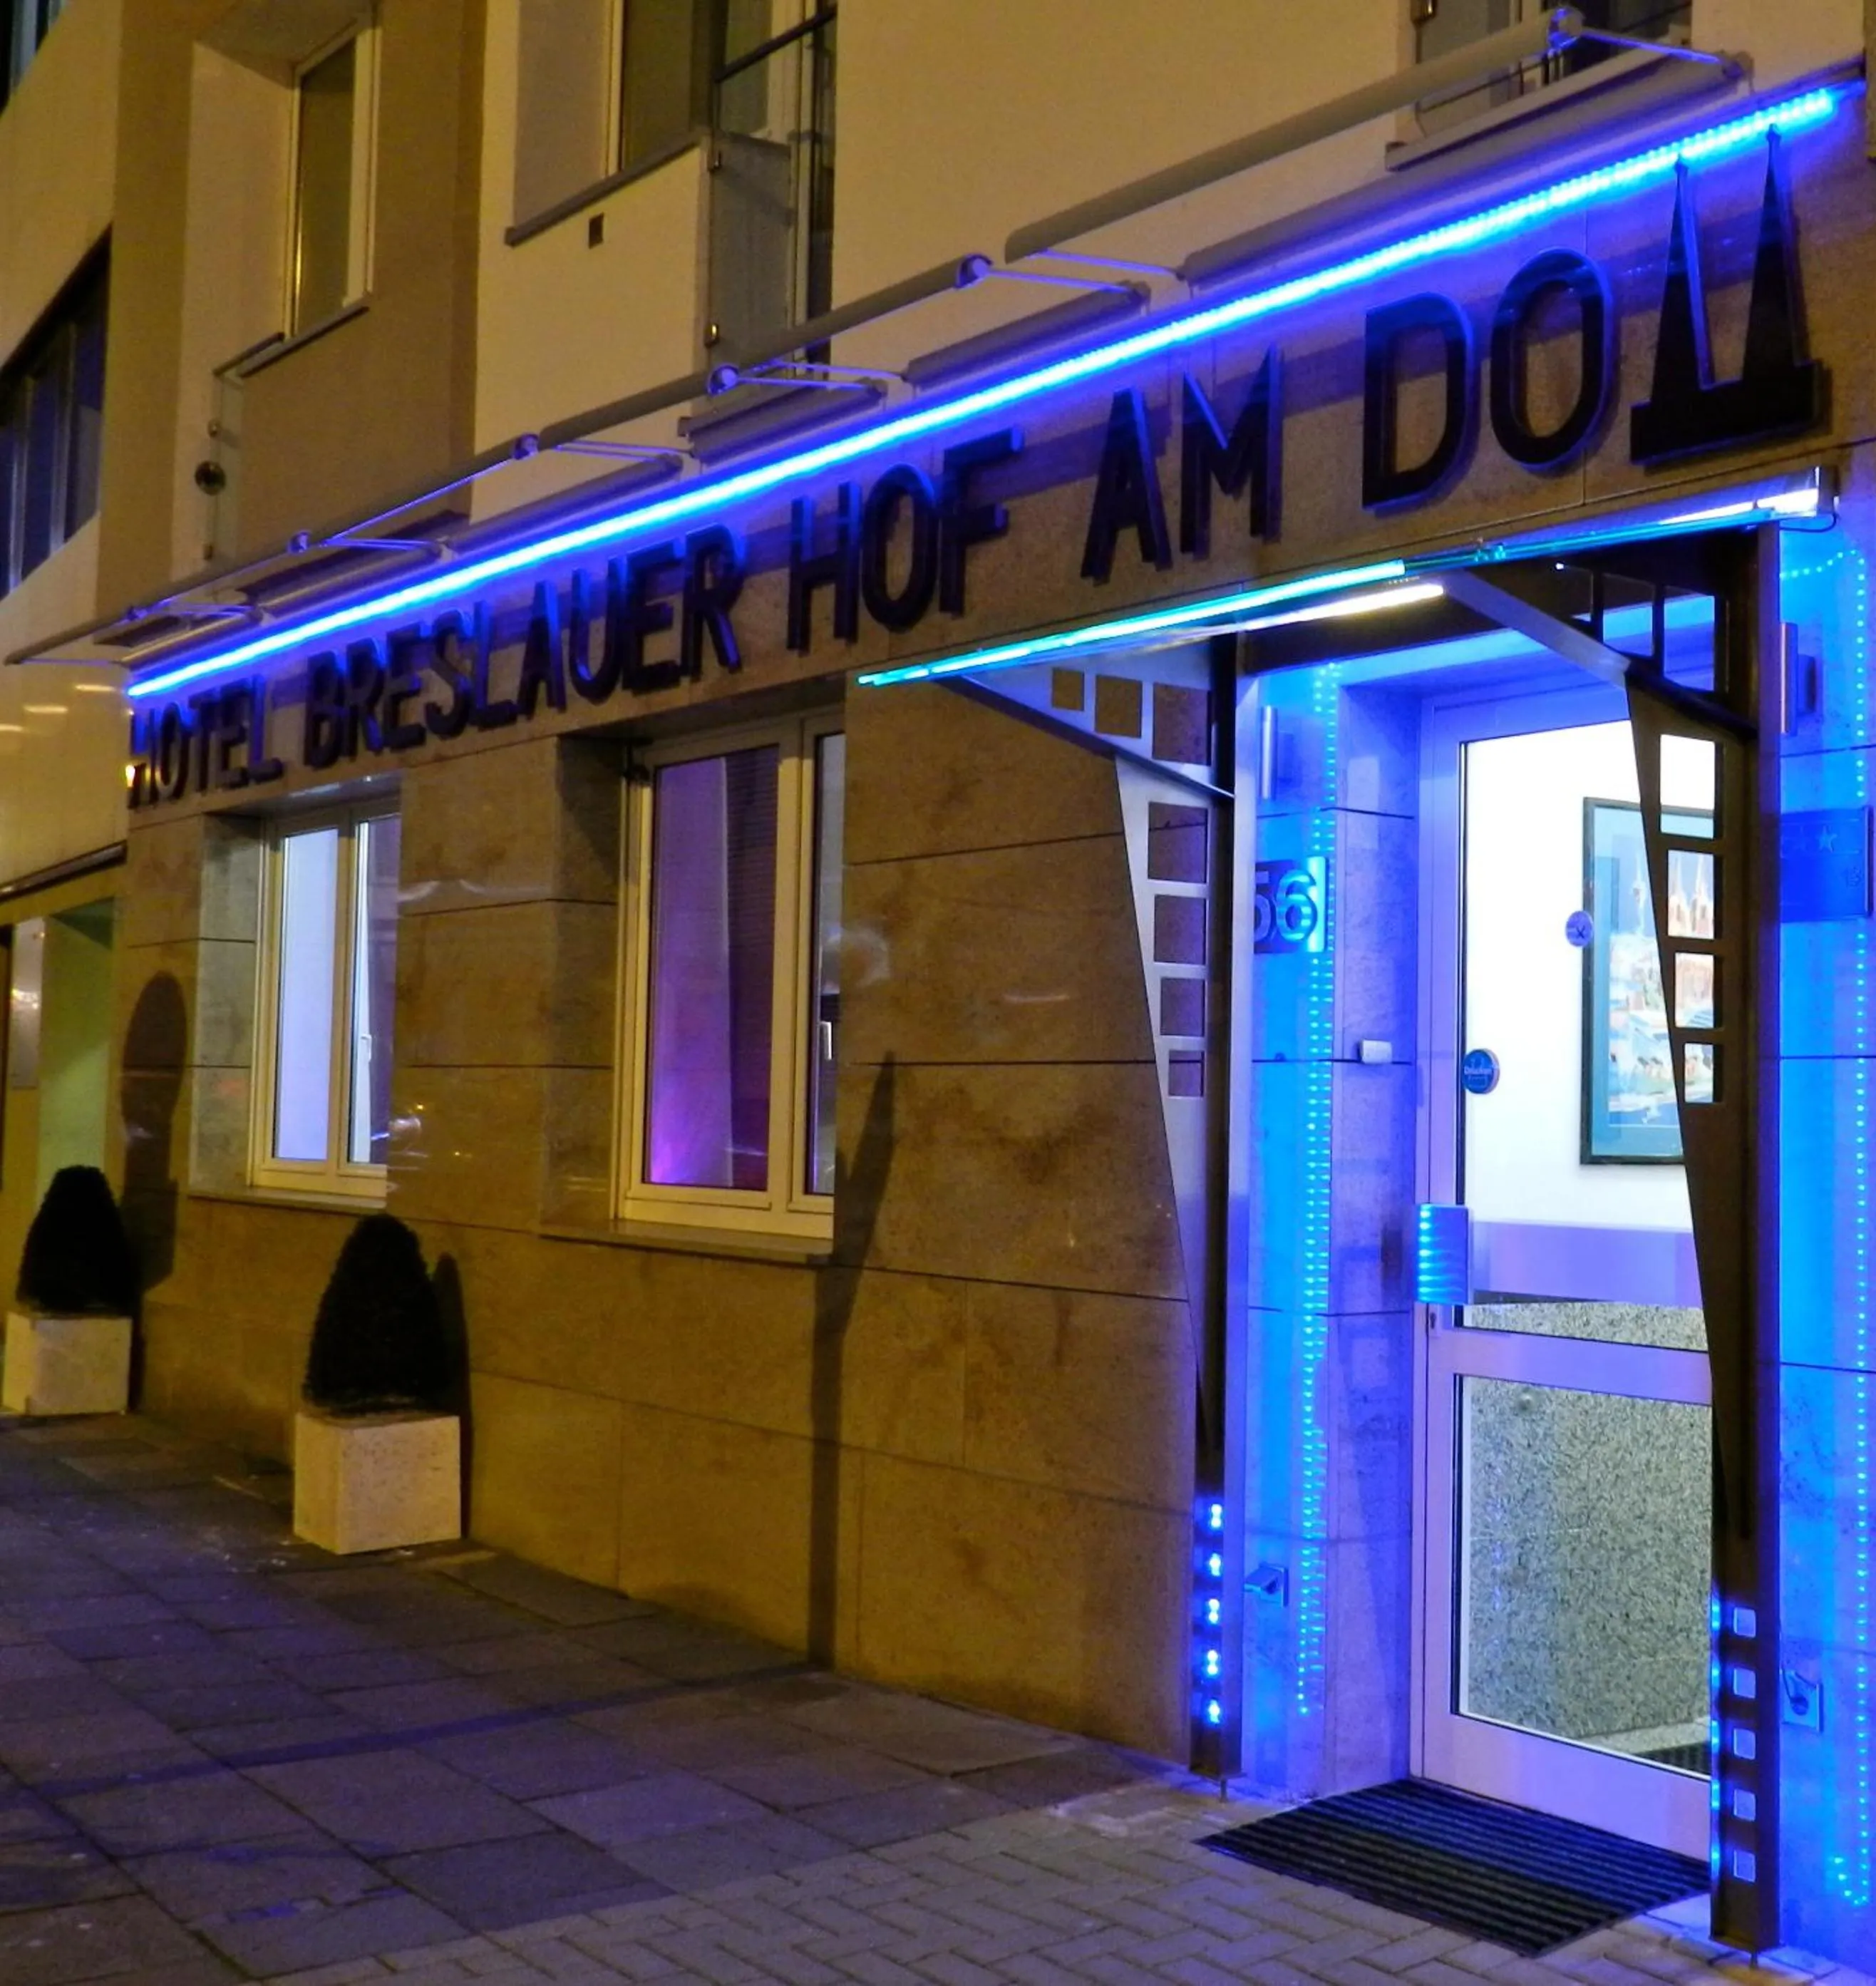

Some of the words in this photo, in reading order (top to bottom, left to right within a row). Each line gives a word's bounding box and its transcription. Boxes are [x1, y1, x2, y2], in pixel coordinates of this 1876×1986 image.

[128, 674, 282, 808] HOTEL
[303, 523, 745, 770] BRESLAUER
[786, 426, 1024, 656] HOF
[1080, 344, 1282, 583] AM
